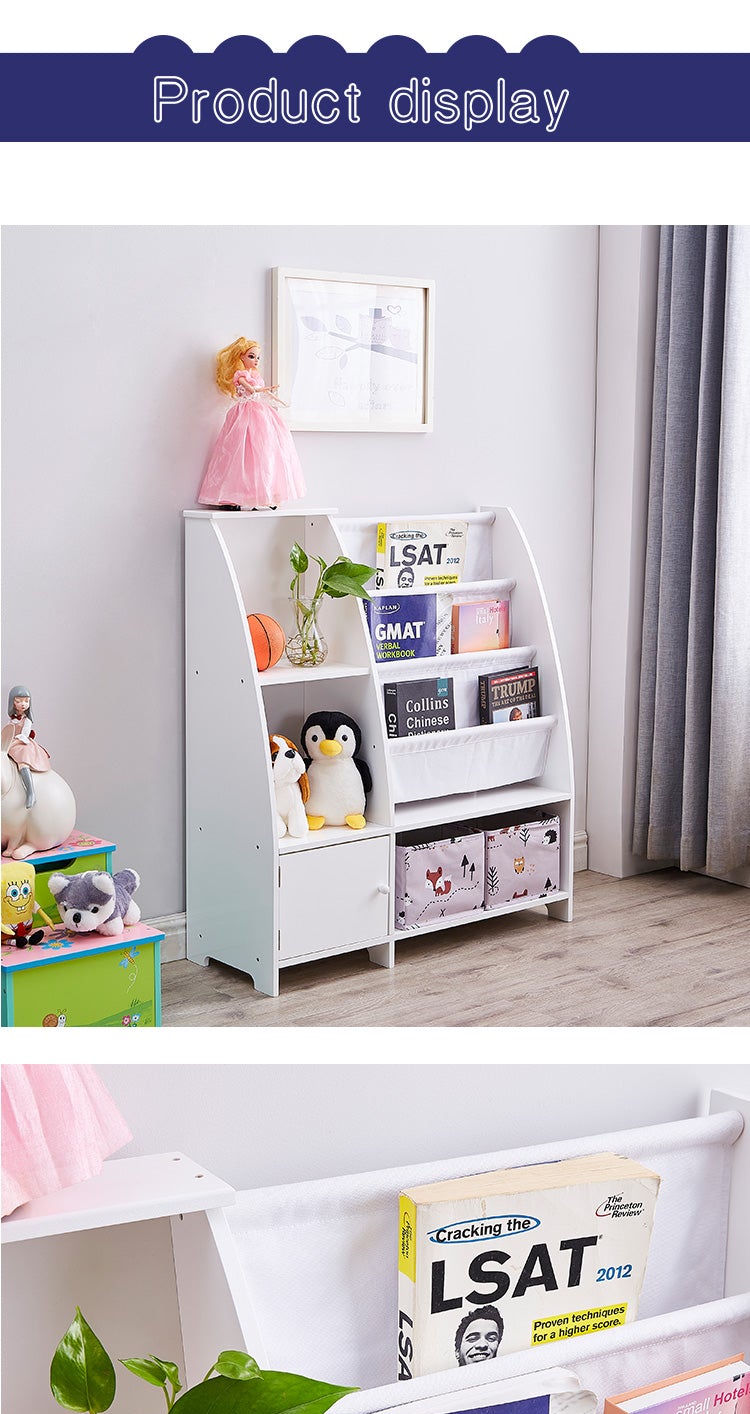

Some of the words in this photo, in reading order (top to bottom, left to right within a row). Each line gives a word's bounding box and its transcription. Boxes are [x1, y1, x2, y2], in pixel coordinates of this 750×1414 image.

[390, 543, 447, 567] LSAT
[375, 621, 424, 641] GMAT
[376, 642, 401, 650] VERBAL
[376, 649, 415, 659] WORKBOOK
[492, 678, 536, 700] TRUMP
[406, 697, 449, 713] Collins
[406, 714, 449, 729] Chinese
[603, 1202, 642, 1212] Princeton
[611, 1210, 641, 1219] Review
[436, 1222, 502, 1243] Cracking
[507, 1219, 530, 1231] the
[430, 1235, 598, 1314] LSAT
[595, 1264, 633, 1282] 2012
[534, 1316, 569, 1331] Proven
[571, 1306, 625, 1323] techniques
[533, 1332, 547, 1343] for
[549, 1330, 556, 1339] a
[559, 1324, 590, 1338] higher
[592, 1318, 621, 1330] score.
[713, 1383, 750, 1407] Hotel
